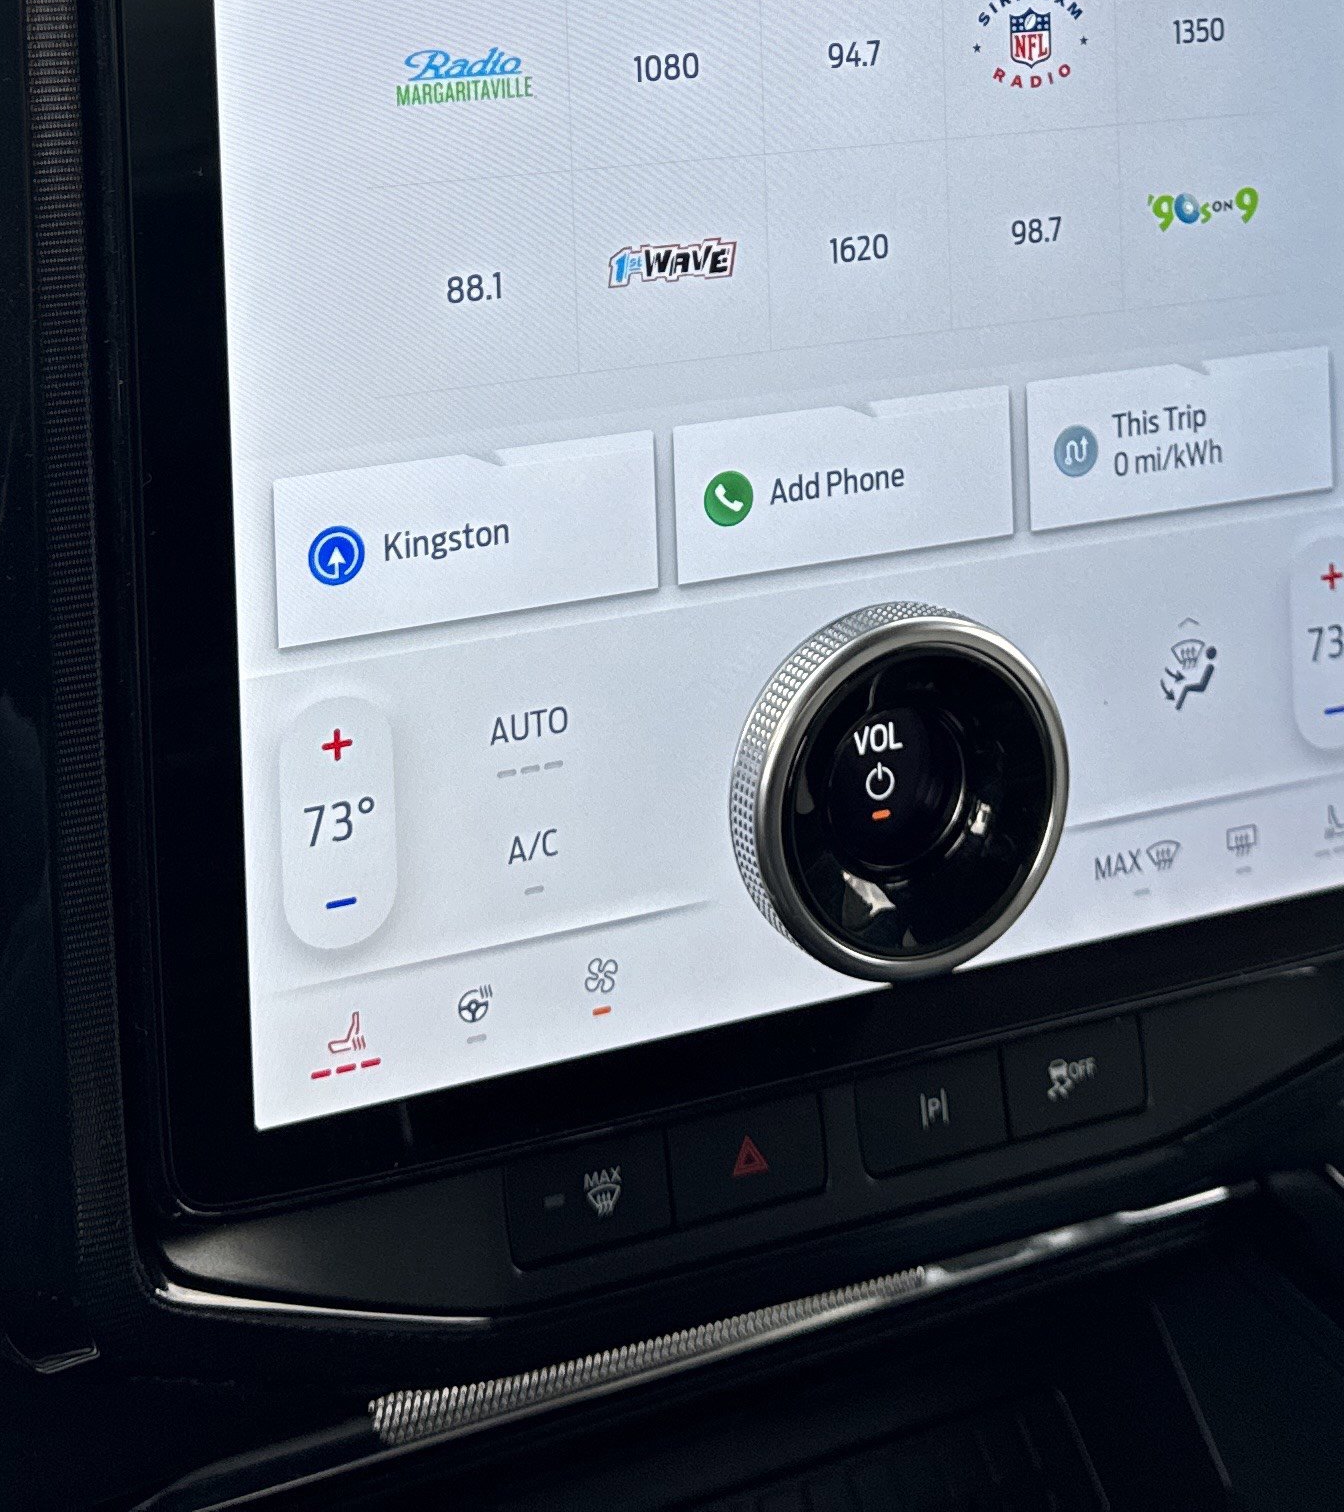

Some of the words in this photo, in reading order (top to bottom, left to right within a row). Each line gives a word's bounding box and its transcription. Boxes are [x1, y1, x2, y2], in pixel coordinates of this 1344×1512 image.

[1172, 17, 1226, 45] 1350
[827, 39, 882, 69] 94.7
[1014, 33, 1048, 62] NFL
[404, 46, 523, 82] Radio
[633, 52, 700, 83] 1080
[992, 63, 1072, 90] RADIO
[395, 76, 534, 108] MARGARITAVILLE
[1011, 216, 1063, 245] 98.7
[644, 244, 731, 277] WAVE
[829, 233, 889, 264] 1620
[446, 272, 503, 304] 88.1
[1112, 412, 1160, 439] This
[1164, 405, 1207, 434] Trip
[1114, 452, 1130, 477] 0
[1135, 441, 1224, 473] mi/kWh
[770, 474, 821, 506] Add
[826, 466, 906, 497] Phone
[383, 521, 510, 562] Kingston
[490, 706, 569, 746] AUTO
[854, 722, 903, 756] VOL
[508, 828, 560, 865] A/C
[1094, 849, 1142, 880] MAX
[584, 1165, 623, 1192] MAX
